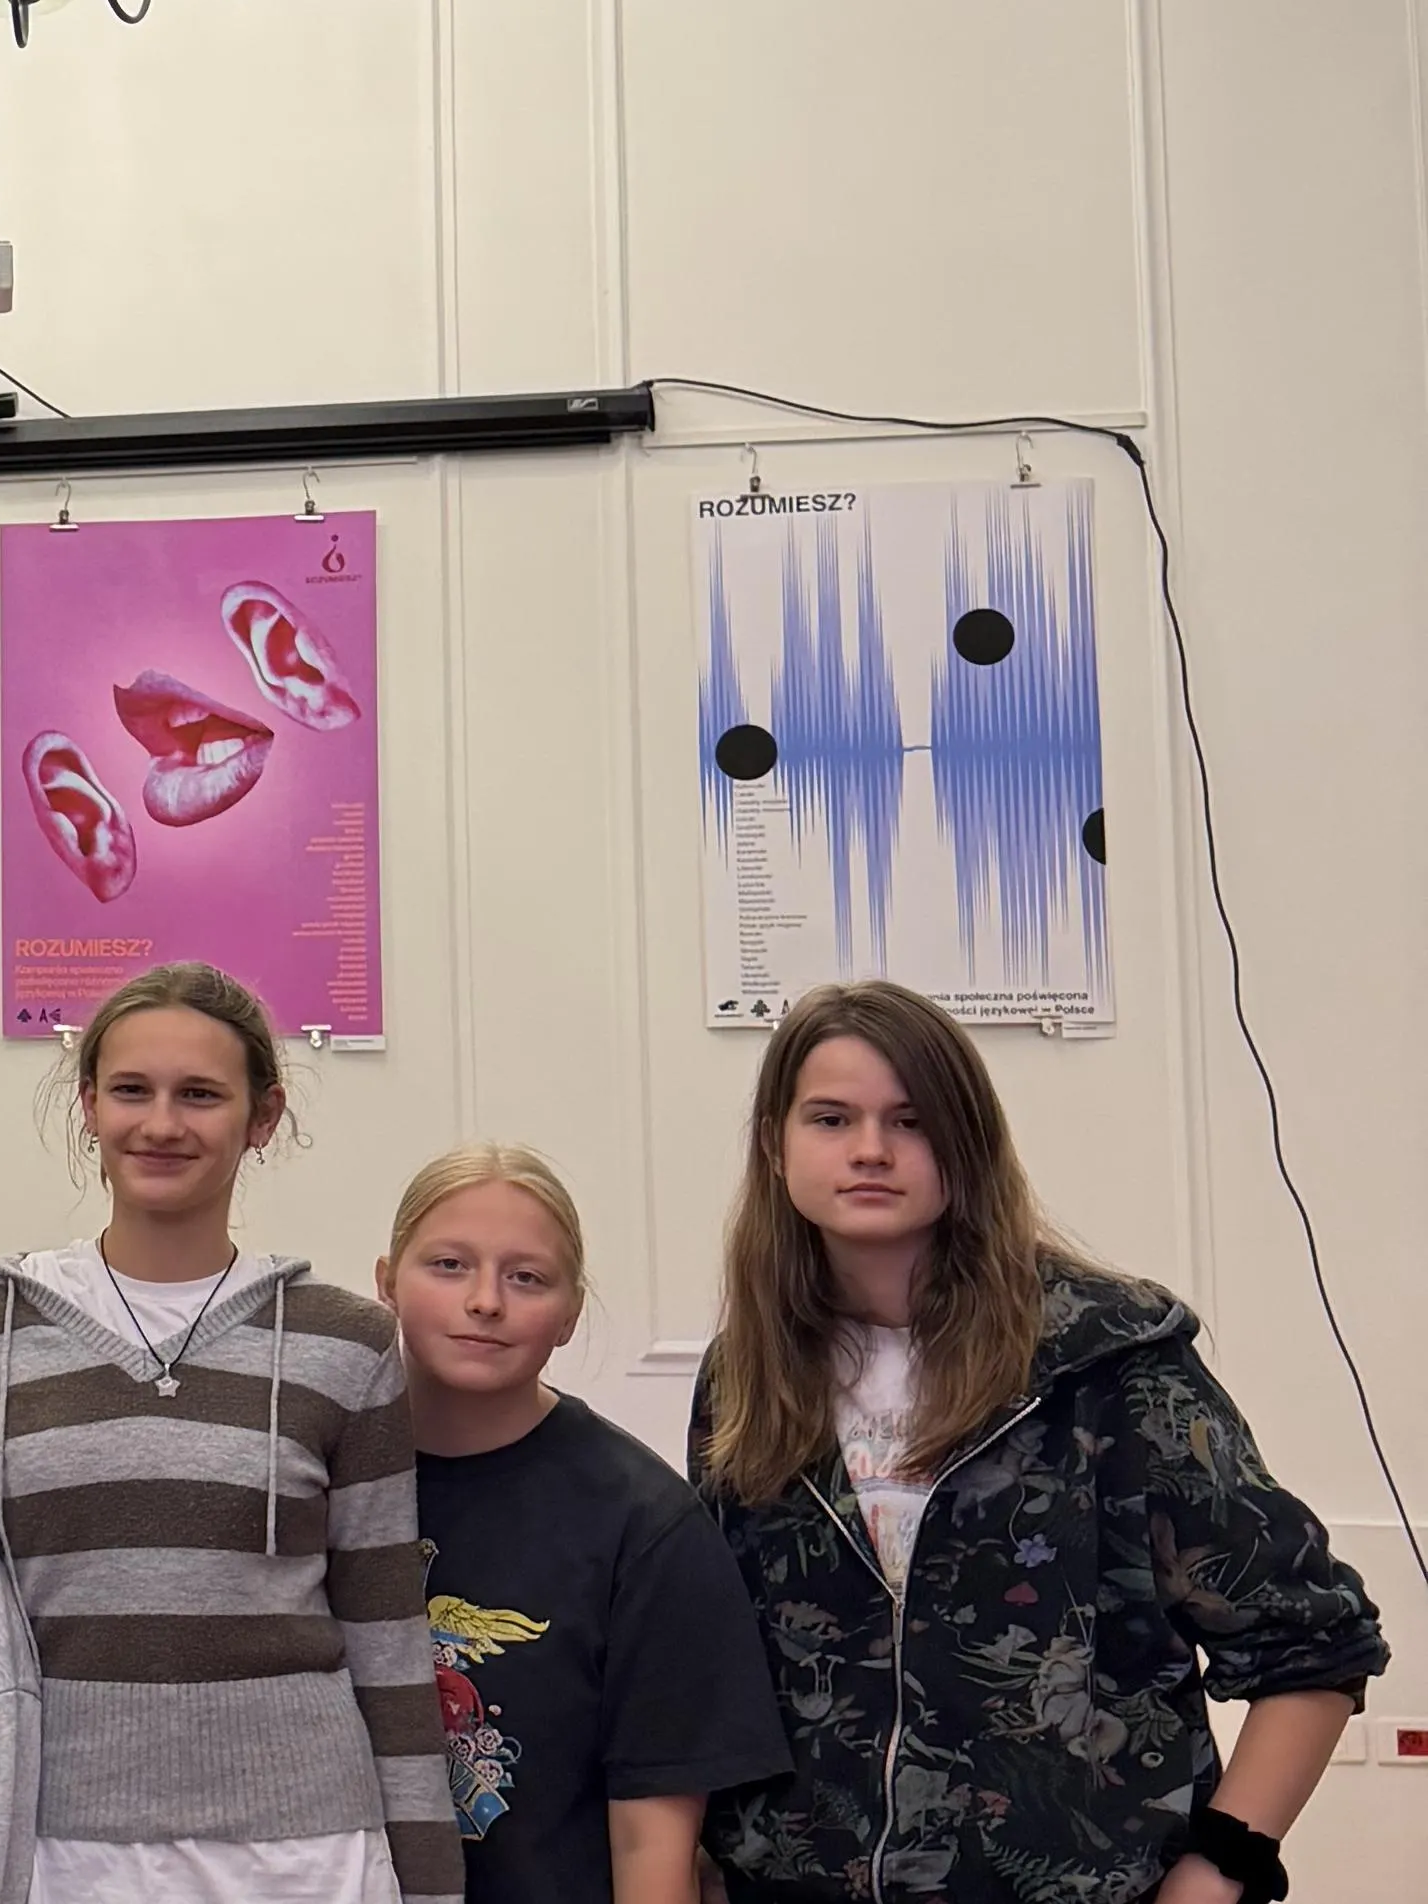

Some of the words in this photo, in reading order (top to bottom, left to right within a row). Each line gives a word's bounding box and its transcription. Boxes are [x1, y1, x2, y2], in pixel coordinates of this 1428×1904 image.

[699, 492, 857, 519] ROZUMIESZ?
[15, 938, 154, 957] ROZUMIESZ?
[1016, 990, 1089, 1002] poświęcona
